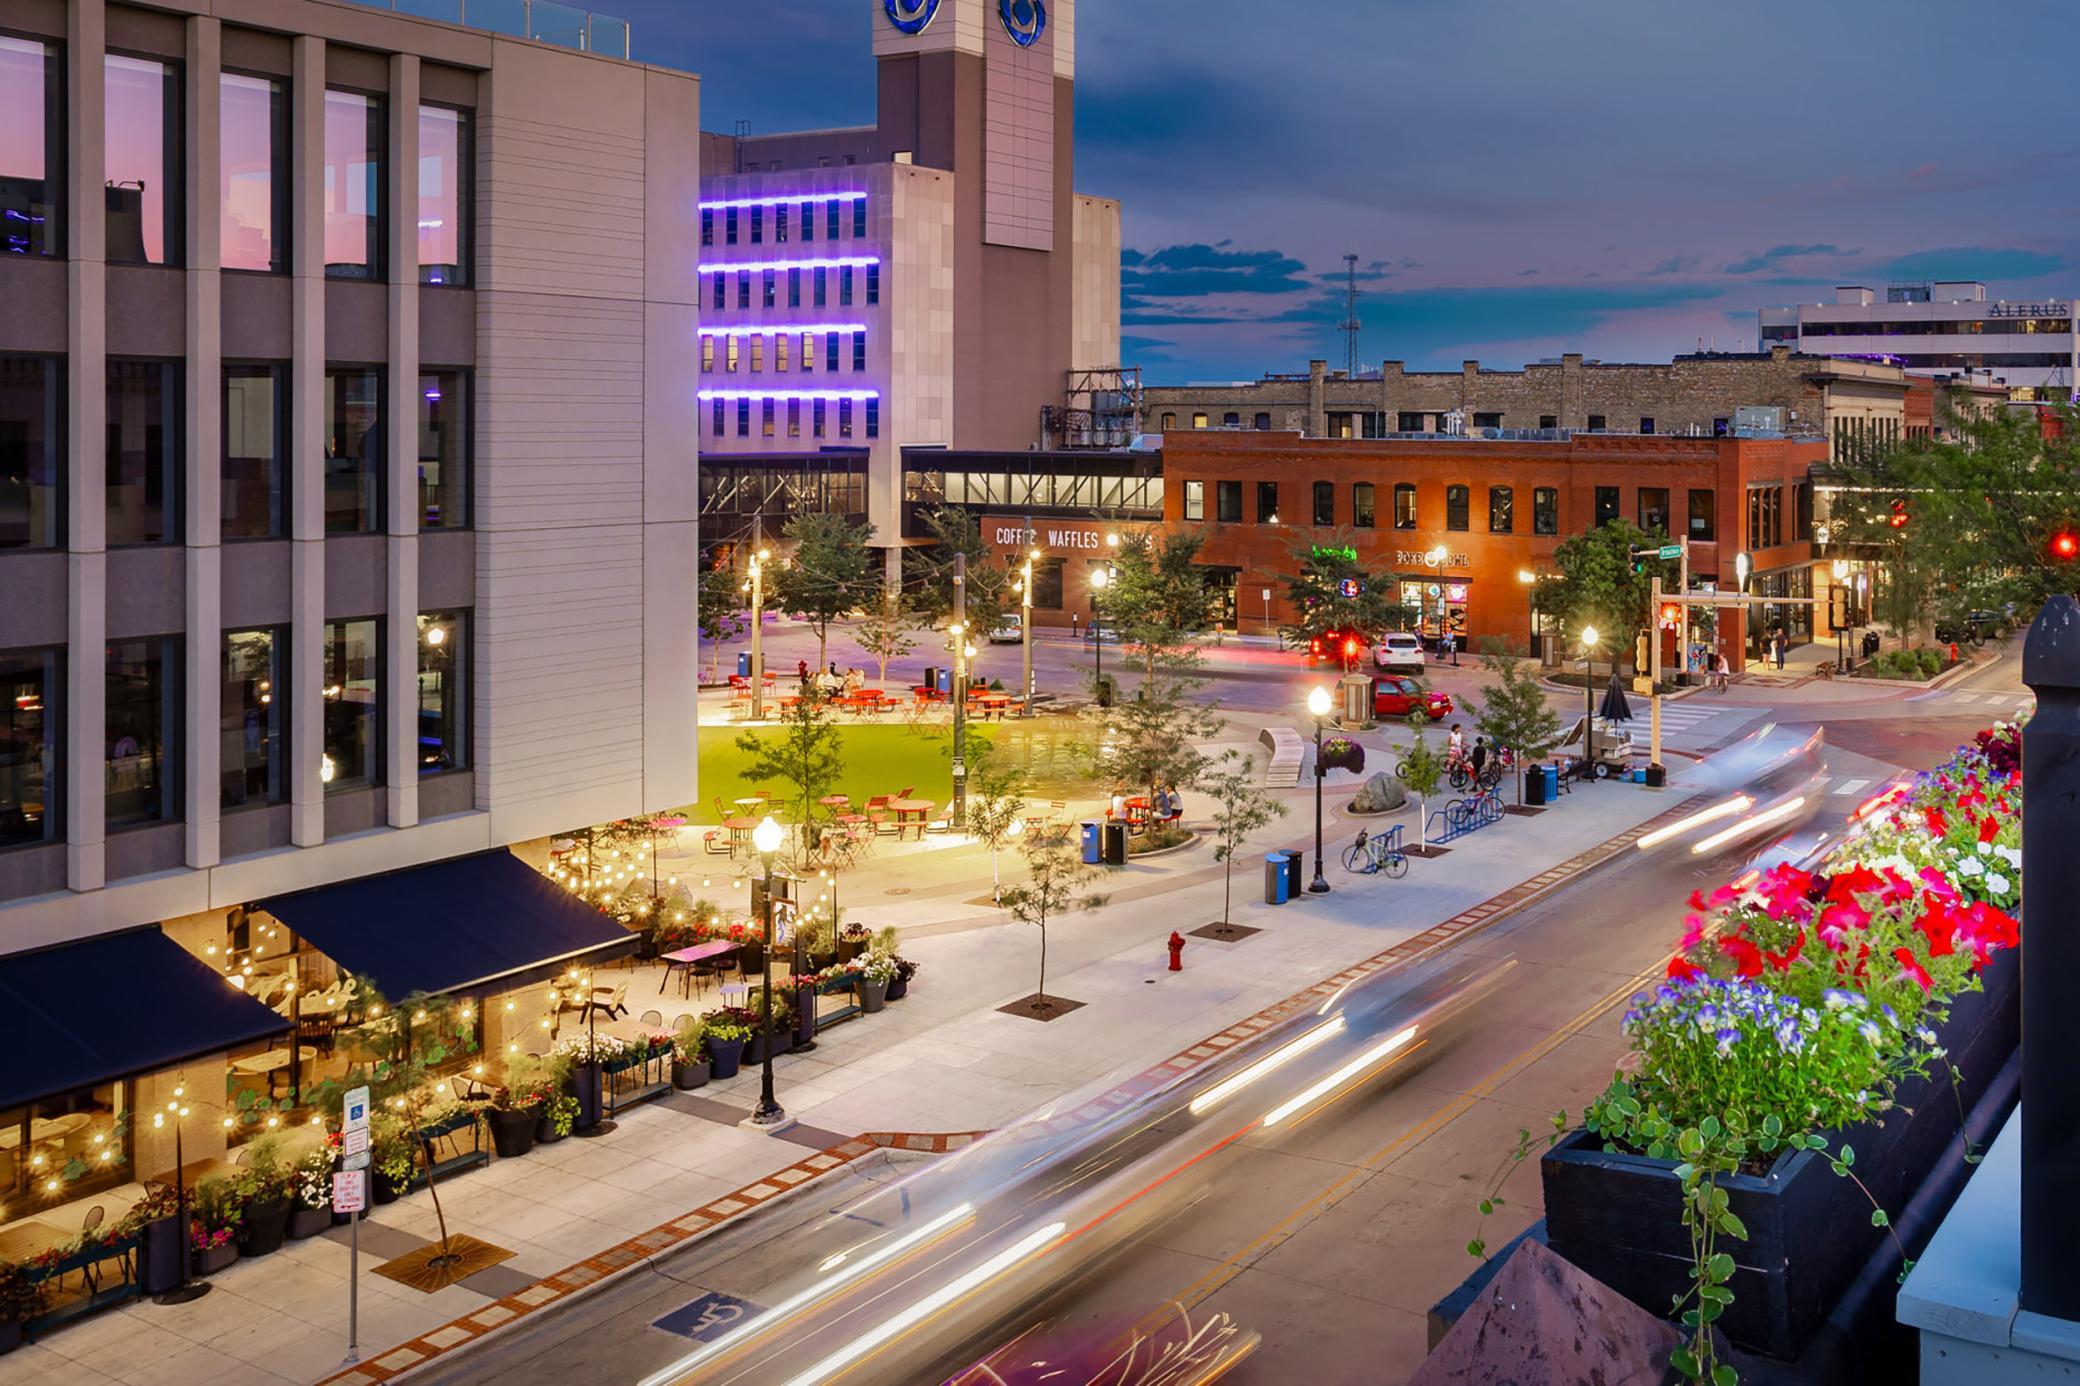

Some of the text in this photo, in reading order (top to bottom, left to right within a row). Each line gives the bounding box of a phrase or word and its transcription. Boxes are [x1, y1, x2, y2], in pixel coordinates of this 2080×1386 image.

[1989, 304, 2068, 317] ALERUS
[996, 527, 1098, 549] COFFE WAFFLES
[1396, 551, 1424, 566] POKE
